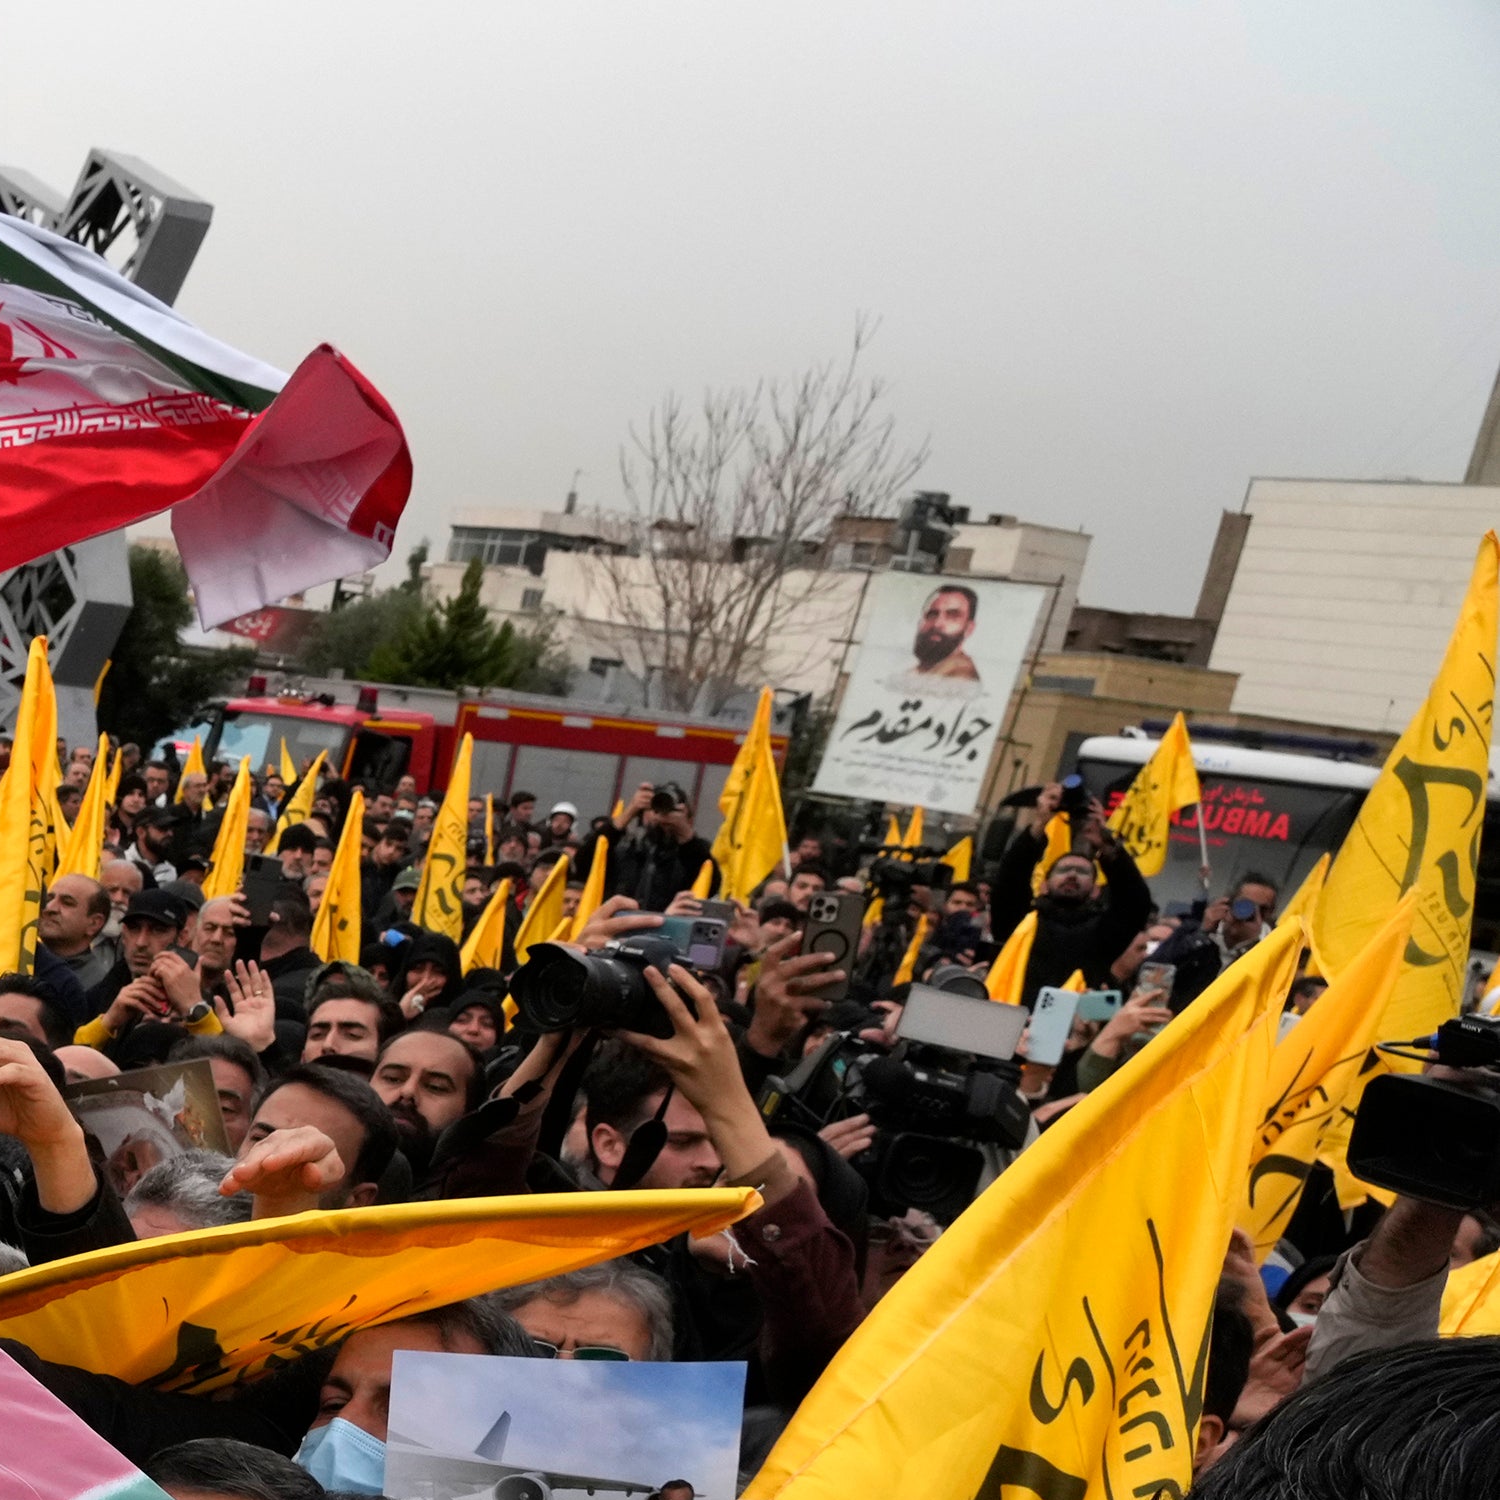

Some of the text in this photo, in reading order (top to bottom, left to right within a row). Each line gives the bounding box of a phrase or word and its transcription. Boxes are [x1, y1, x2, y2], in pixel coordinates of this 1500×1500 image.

[840, 699, 932, 745] مقدم
[924, 701, 992, 761] جواد
[1460, 1023, 1482, 1034] SONY
